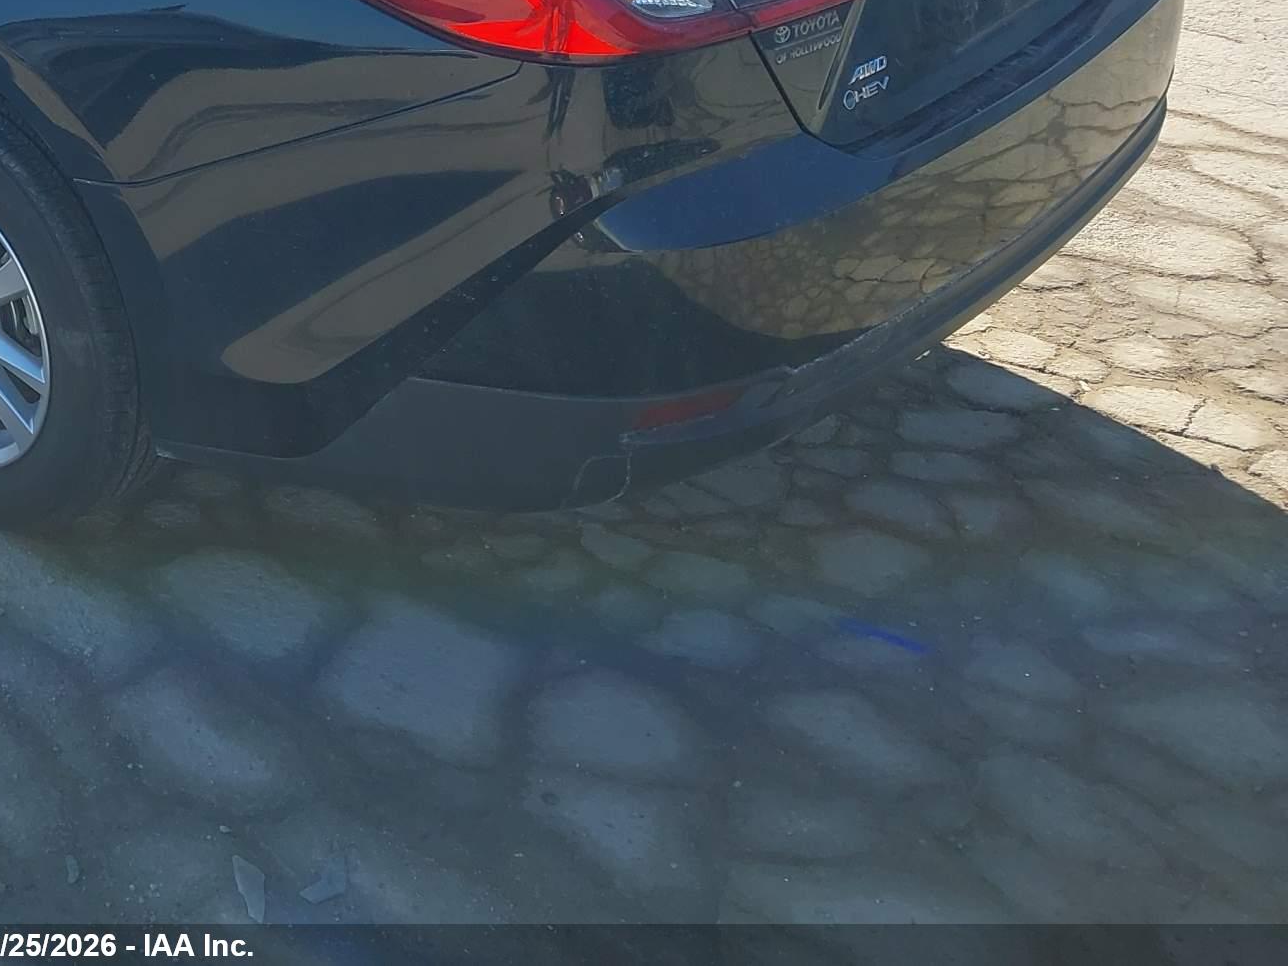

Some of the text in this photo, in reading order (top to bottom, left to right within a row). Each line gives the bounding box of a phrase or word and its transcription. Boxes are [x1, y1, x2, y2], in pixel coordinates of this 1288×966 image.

[792, 10, 840, 37] TOYOTA
[775, 52, 787, 64] OF
[848, 55, 888, 85] AWD
